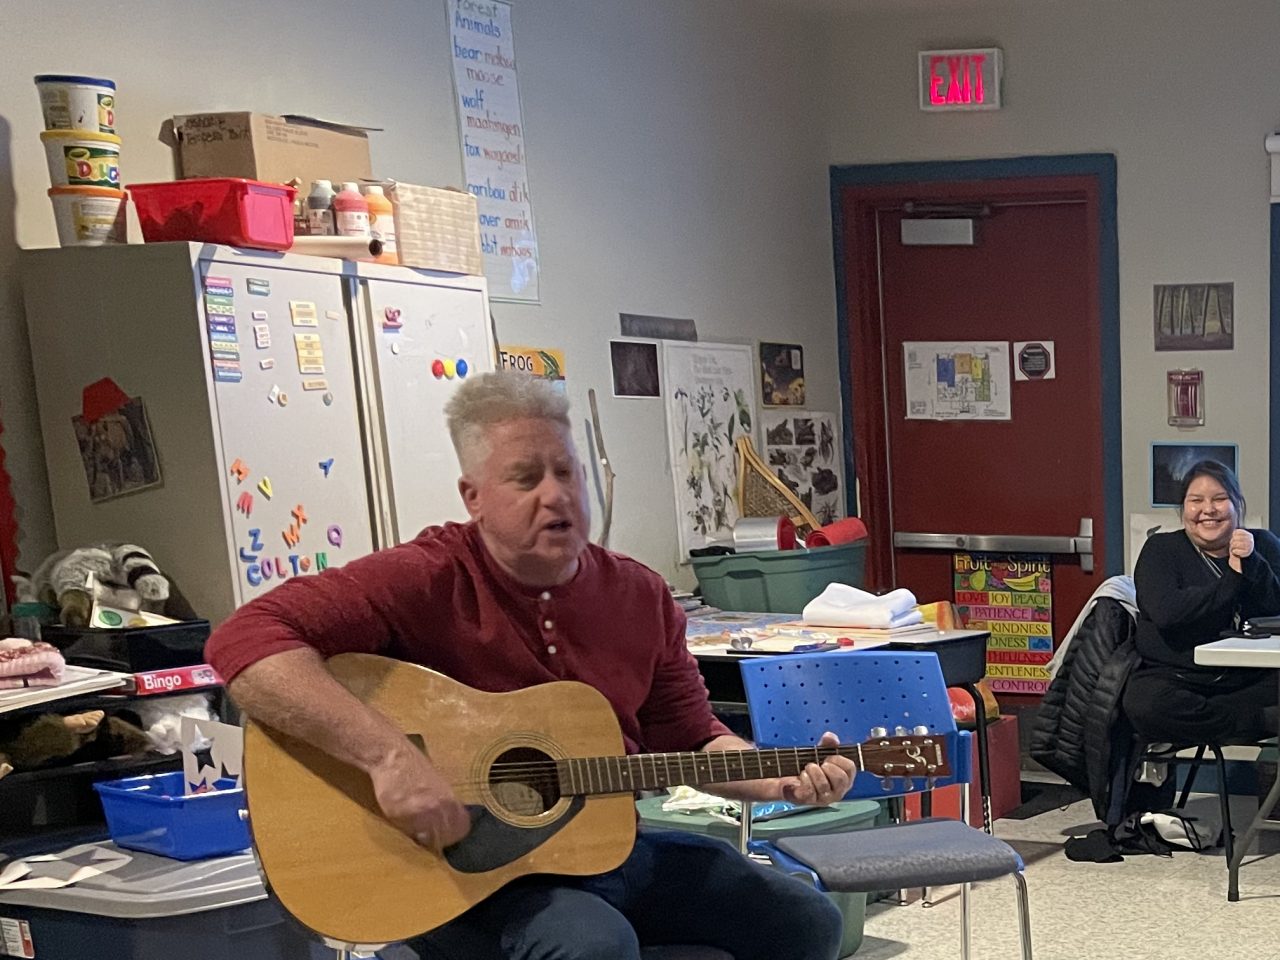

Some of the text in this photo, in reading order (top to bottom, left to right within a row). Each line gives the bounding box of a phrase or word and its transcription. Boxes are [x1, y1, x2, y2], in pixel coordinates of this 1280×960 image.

[455, 10, 502, 38] Animals
[453, 35, 481, 60] bear
[929, 54, 985, 105] EXIT
[462, 87, 485, 110] wolf
[464, 134, 481, 158] fox
[499, 351, 534, 372] FROG
[1007, 554, 1051, 578] Spirit
[956, 591, 1050, 605] LOVE JOY PEACE
[974, 607, 1030, 620] PATIENCE
[991, 622, 1048, 636] KINDNESS
[142, 675, 182, 690] Bingo
